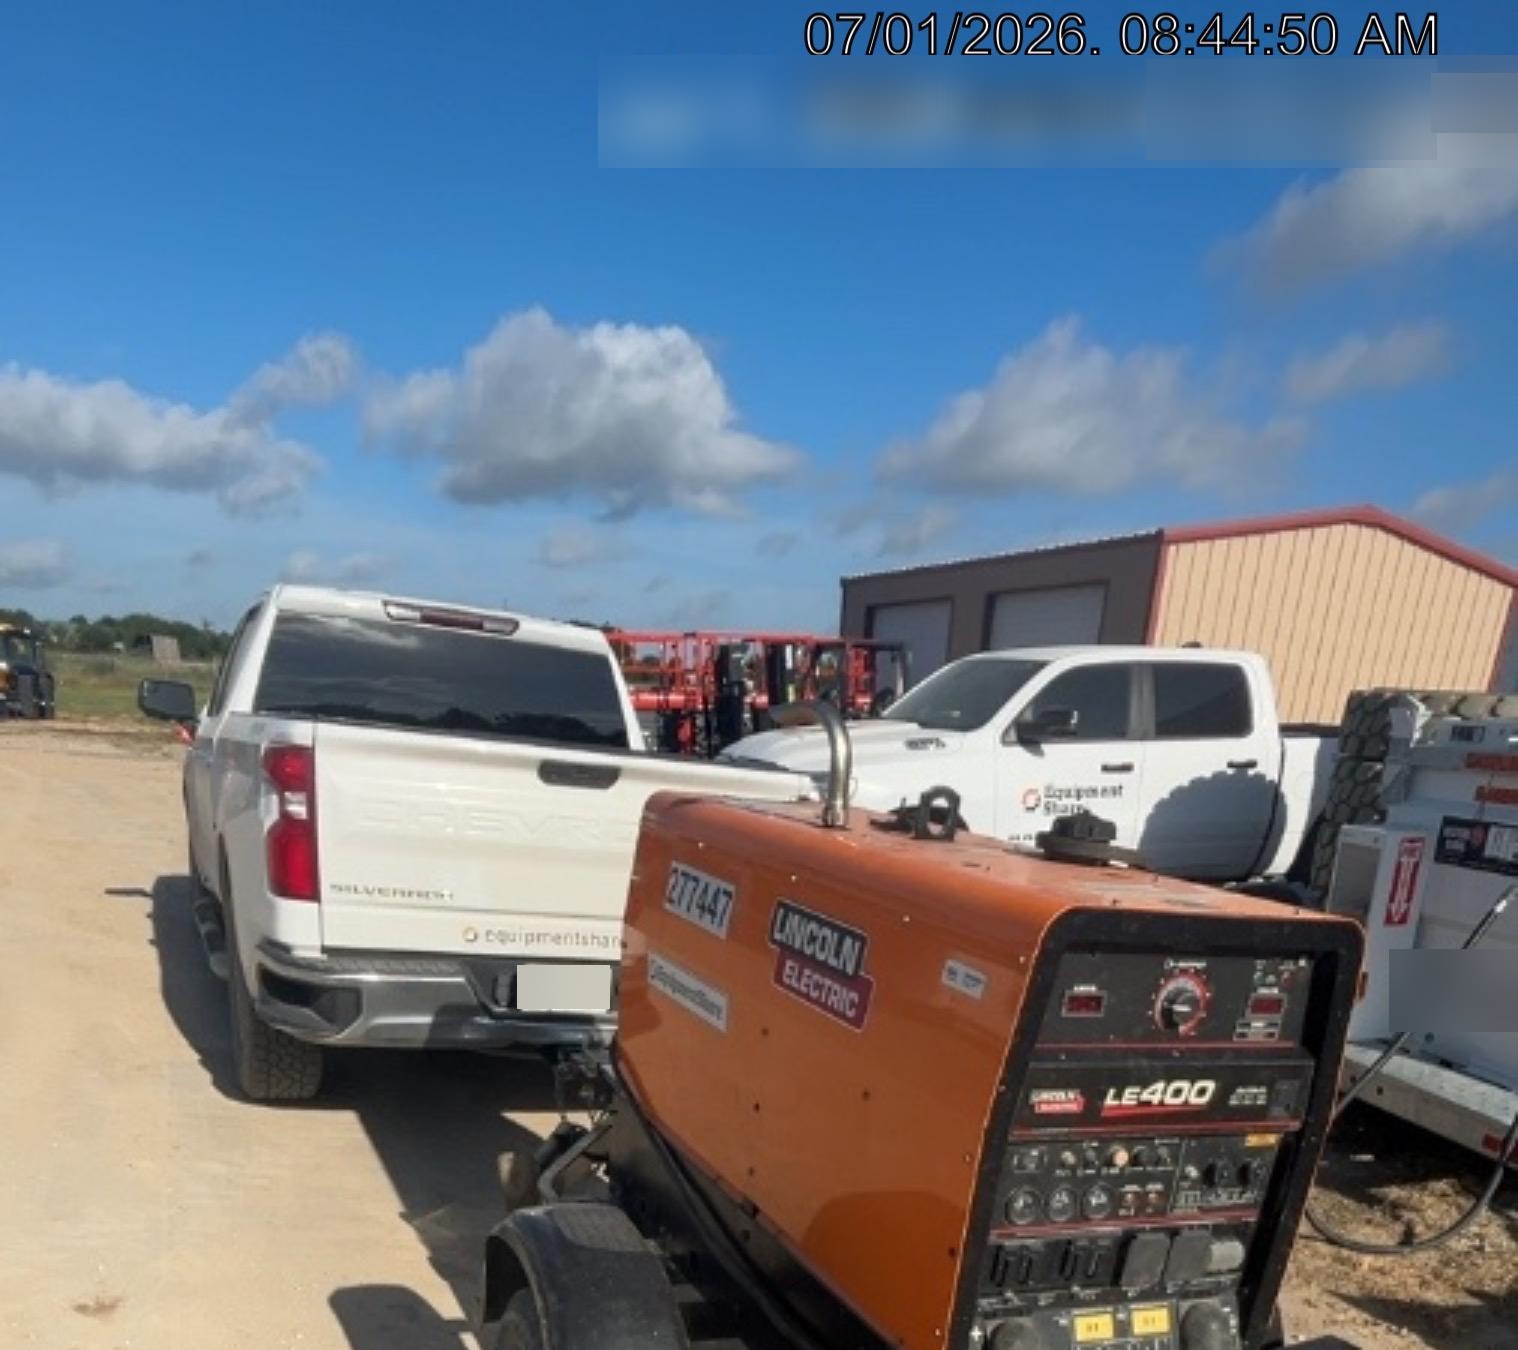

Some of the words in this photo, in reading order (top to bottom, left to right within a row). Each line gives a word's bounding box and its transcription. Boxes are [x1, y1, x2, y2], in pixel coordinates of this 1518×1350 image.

[667, 865, 734, 930] 277447
[485, 929, 621, 949] equipmentshar
[773, 907, 861, 977] LINCOLN
[782, 958, 860, 1019] ELECTRIC
[1104, 1079, 1217, 1106] LE400
